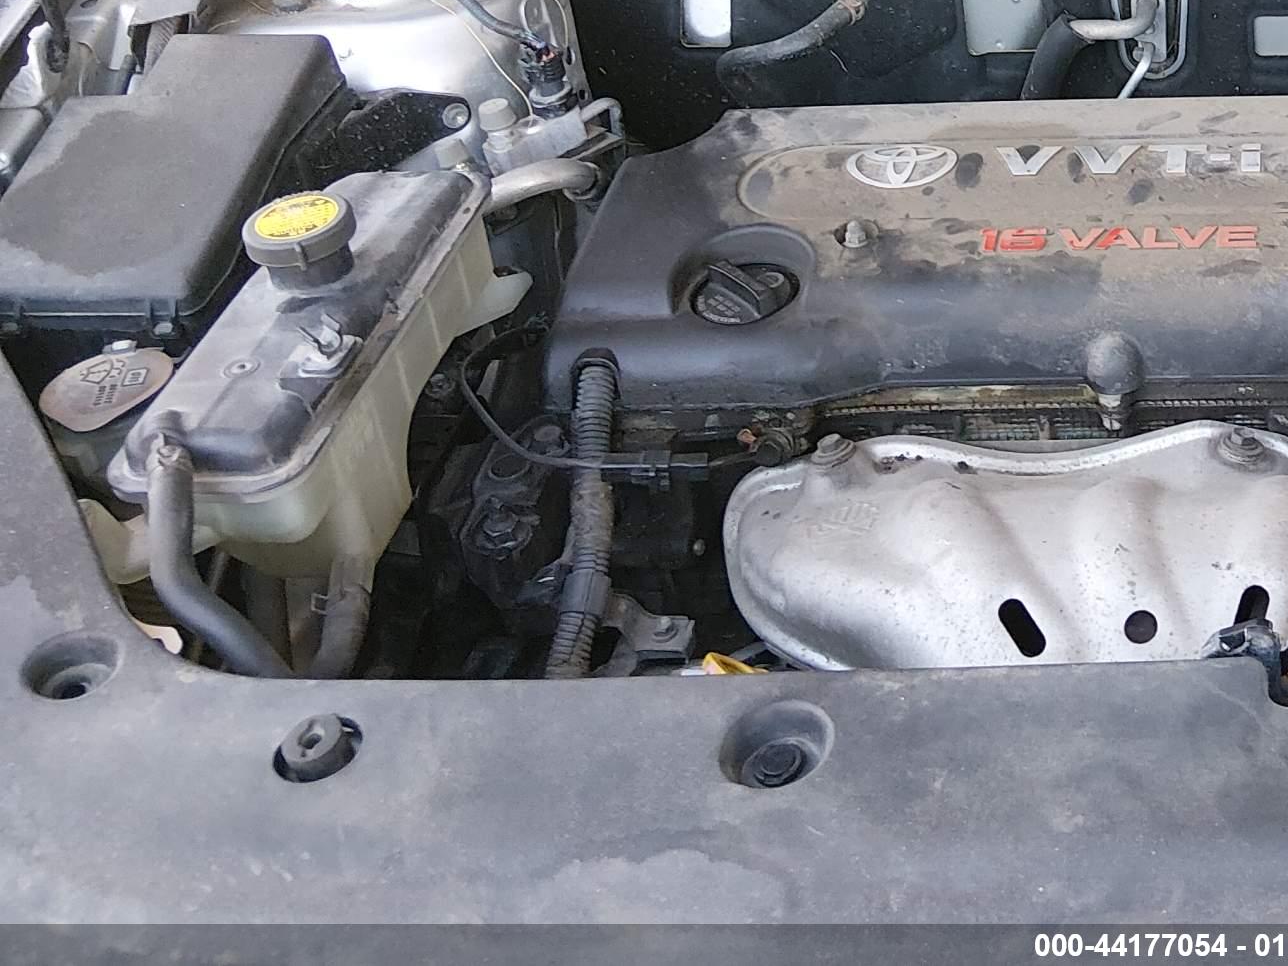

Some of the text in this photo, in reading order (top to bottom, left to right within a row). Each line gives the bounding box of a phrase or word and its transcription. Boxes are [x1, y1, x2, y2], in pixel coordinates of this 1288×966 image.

[995, 144, 1264, 176] VVT-i
[980, 225, 1258, 252] 16 VALVE
